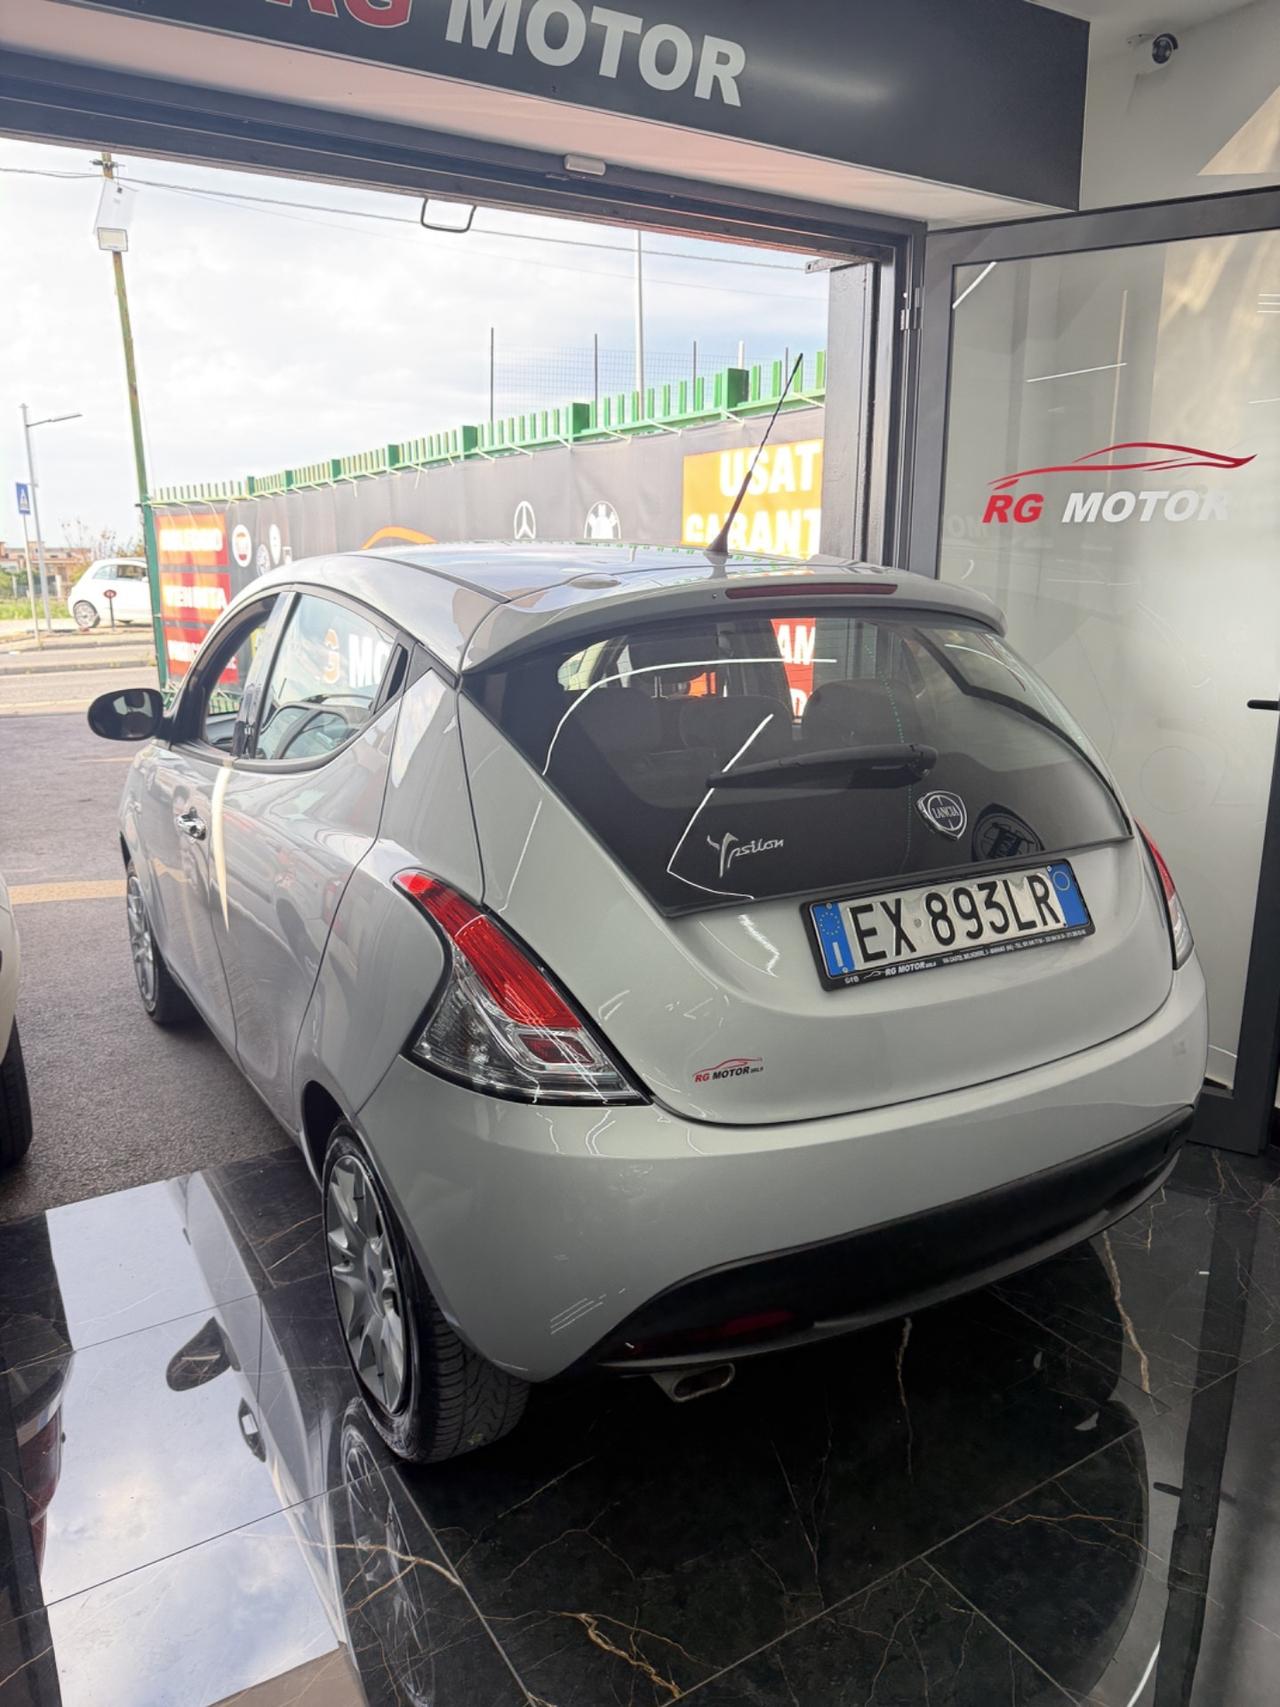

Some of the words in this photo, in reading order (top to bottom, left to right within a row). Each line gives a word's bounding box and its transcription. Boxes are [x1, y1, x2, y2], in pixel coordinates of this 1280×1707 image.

[445, 0, 747, 107] MOTOR
[982, 493, 1044, 524] RG
[1061, 489, 1232, 524] MOTOR
[707, 832, 785, 878] Ypsilon
[850, 897, 917, 963] EX
[925, 873, 1061, 947] 893LR
[898, 961, 925, 974] MOTOR
[695, 1073, 710, 1083] RG
[712, 1066, 750, 1080] MOTOR
